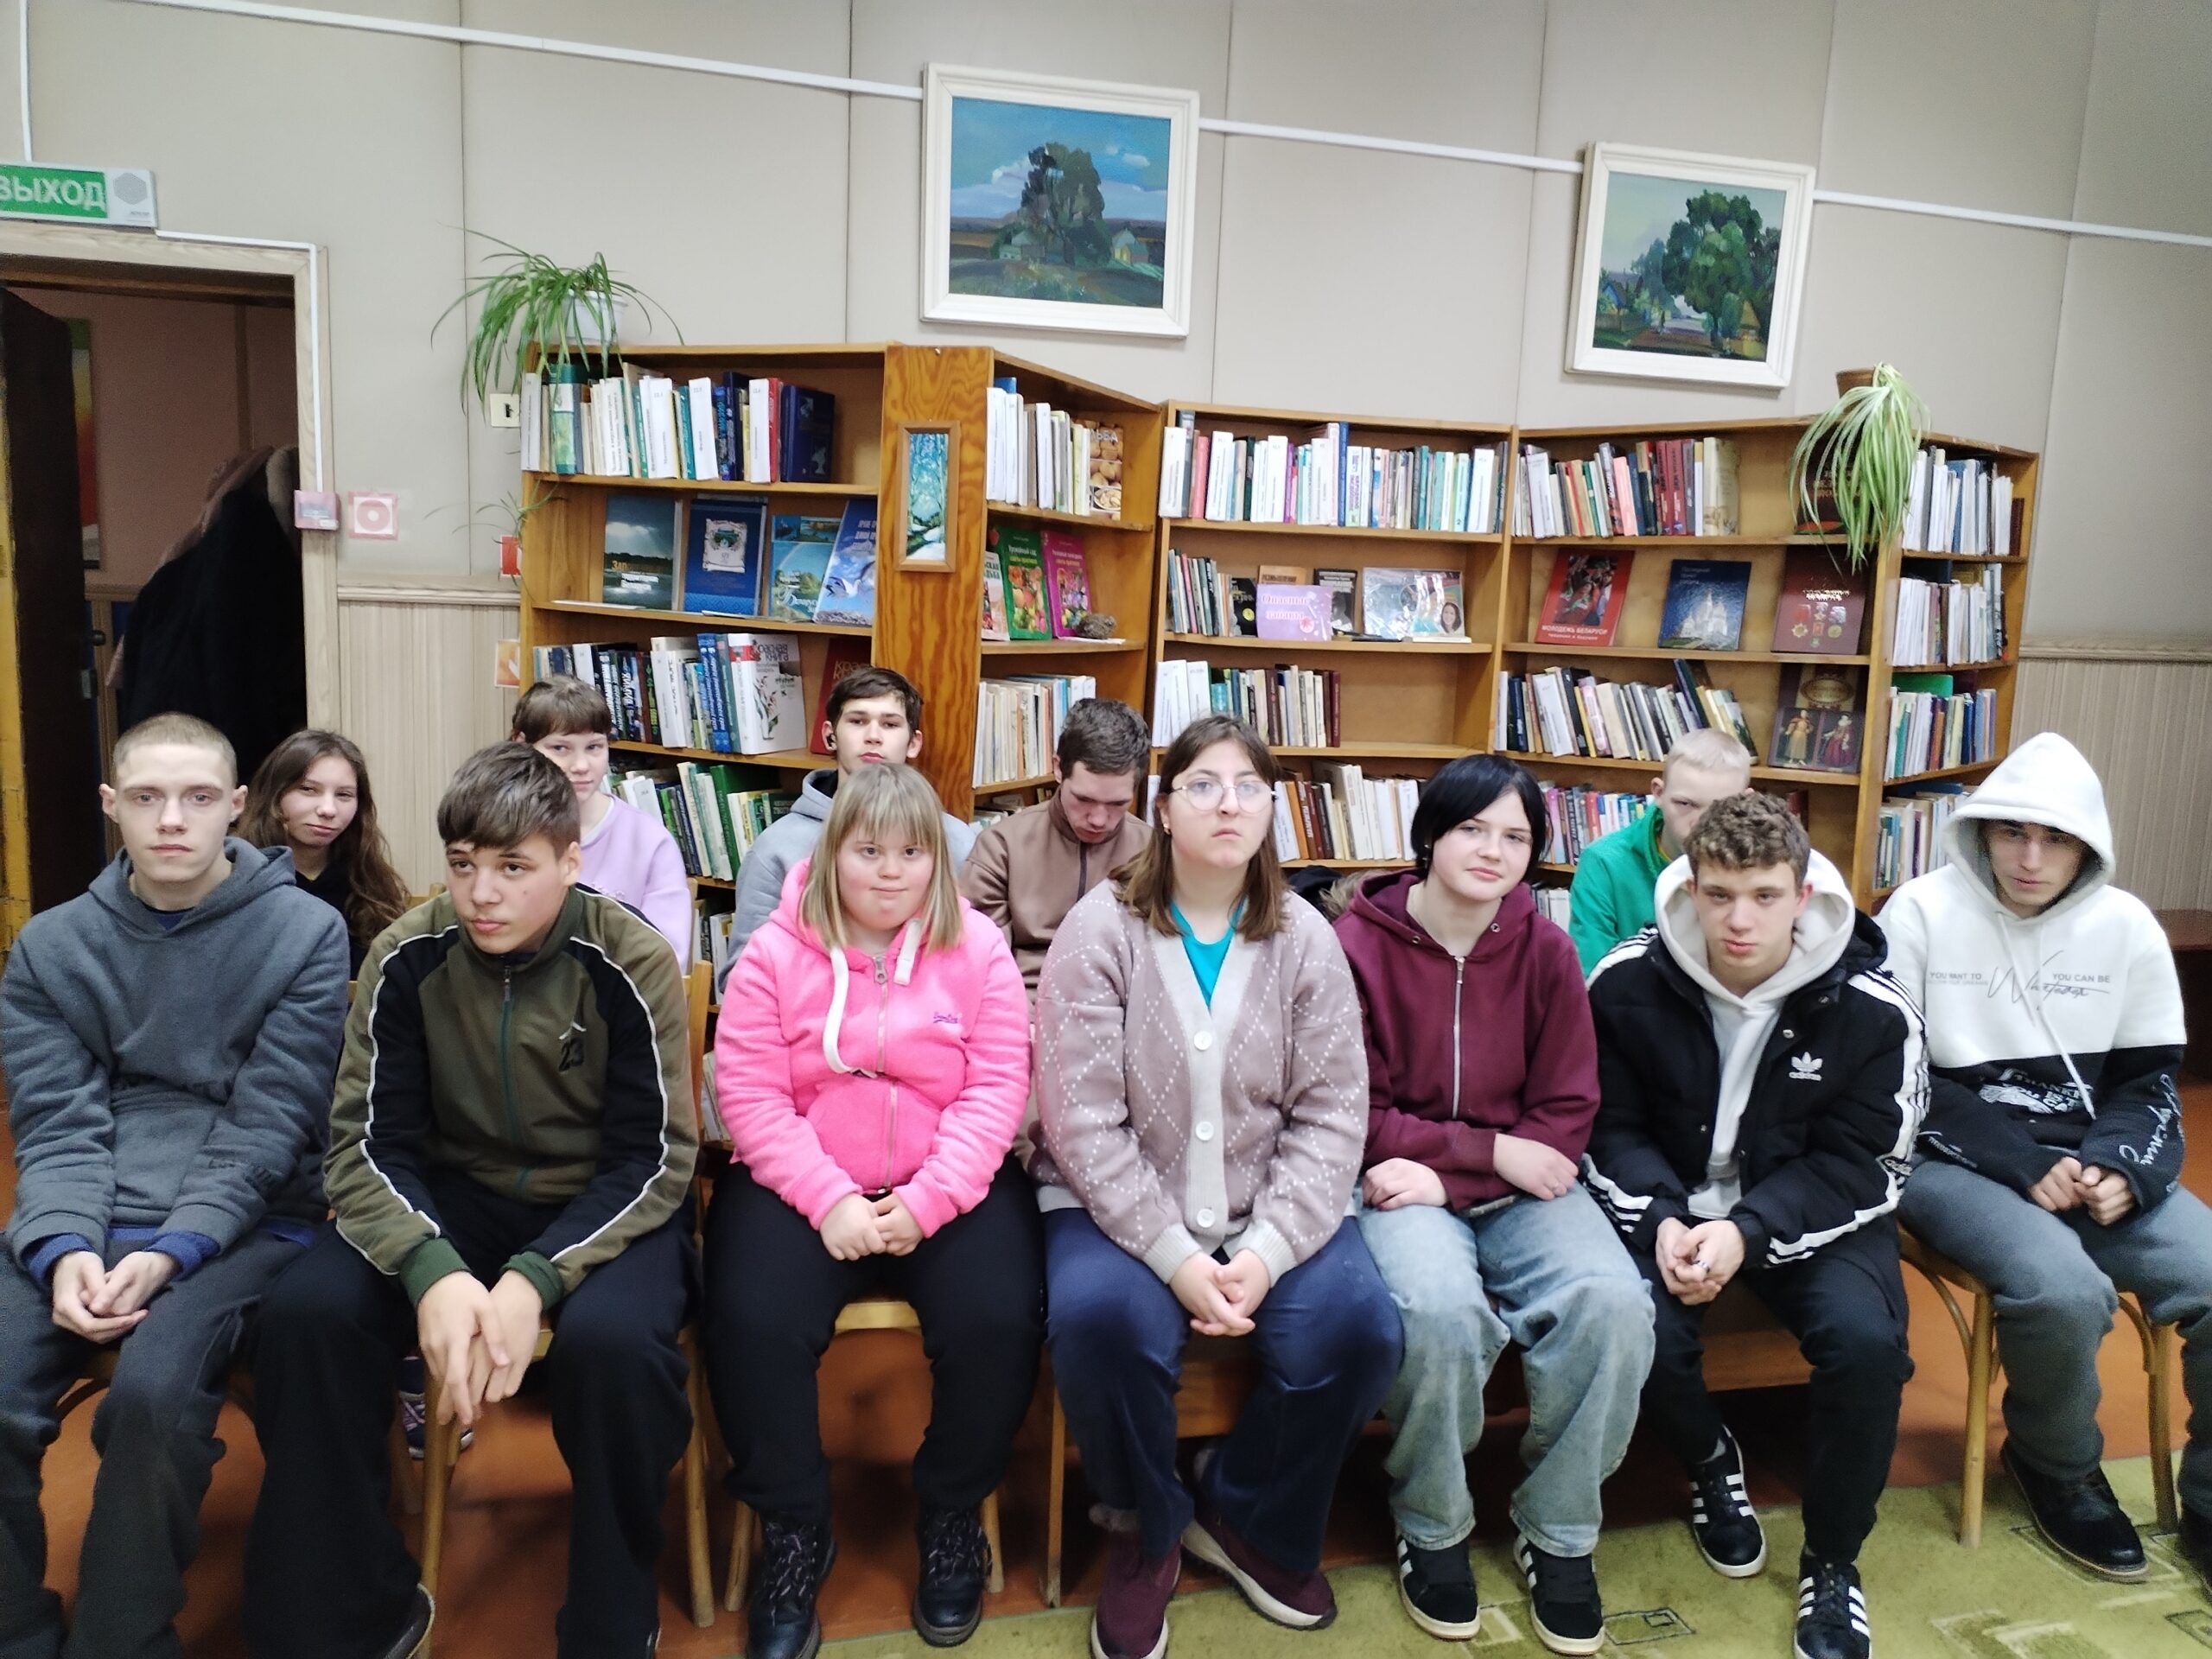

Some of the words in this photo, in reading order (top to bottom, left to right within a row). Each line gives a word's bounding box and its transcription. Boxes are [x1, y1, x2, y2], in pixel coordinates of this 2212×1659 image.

[0, 175, 105, 212] ВЫХОД
[2053, 973, 2072, 982] YOU
[2074, 974, 2094, 982] CAN
[2097, 975, 2111, 983] BE
